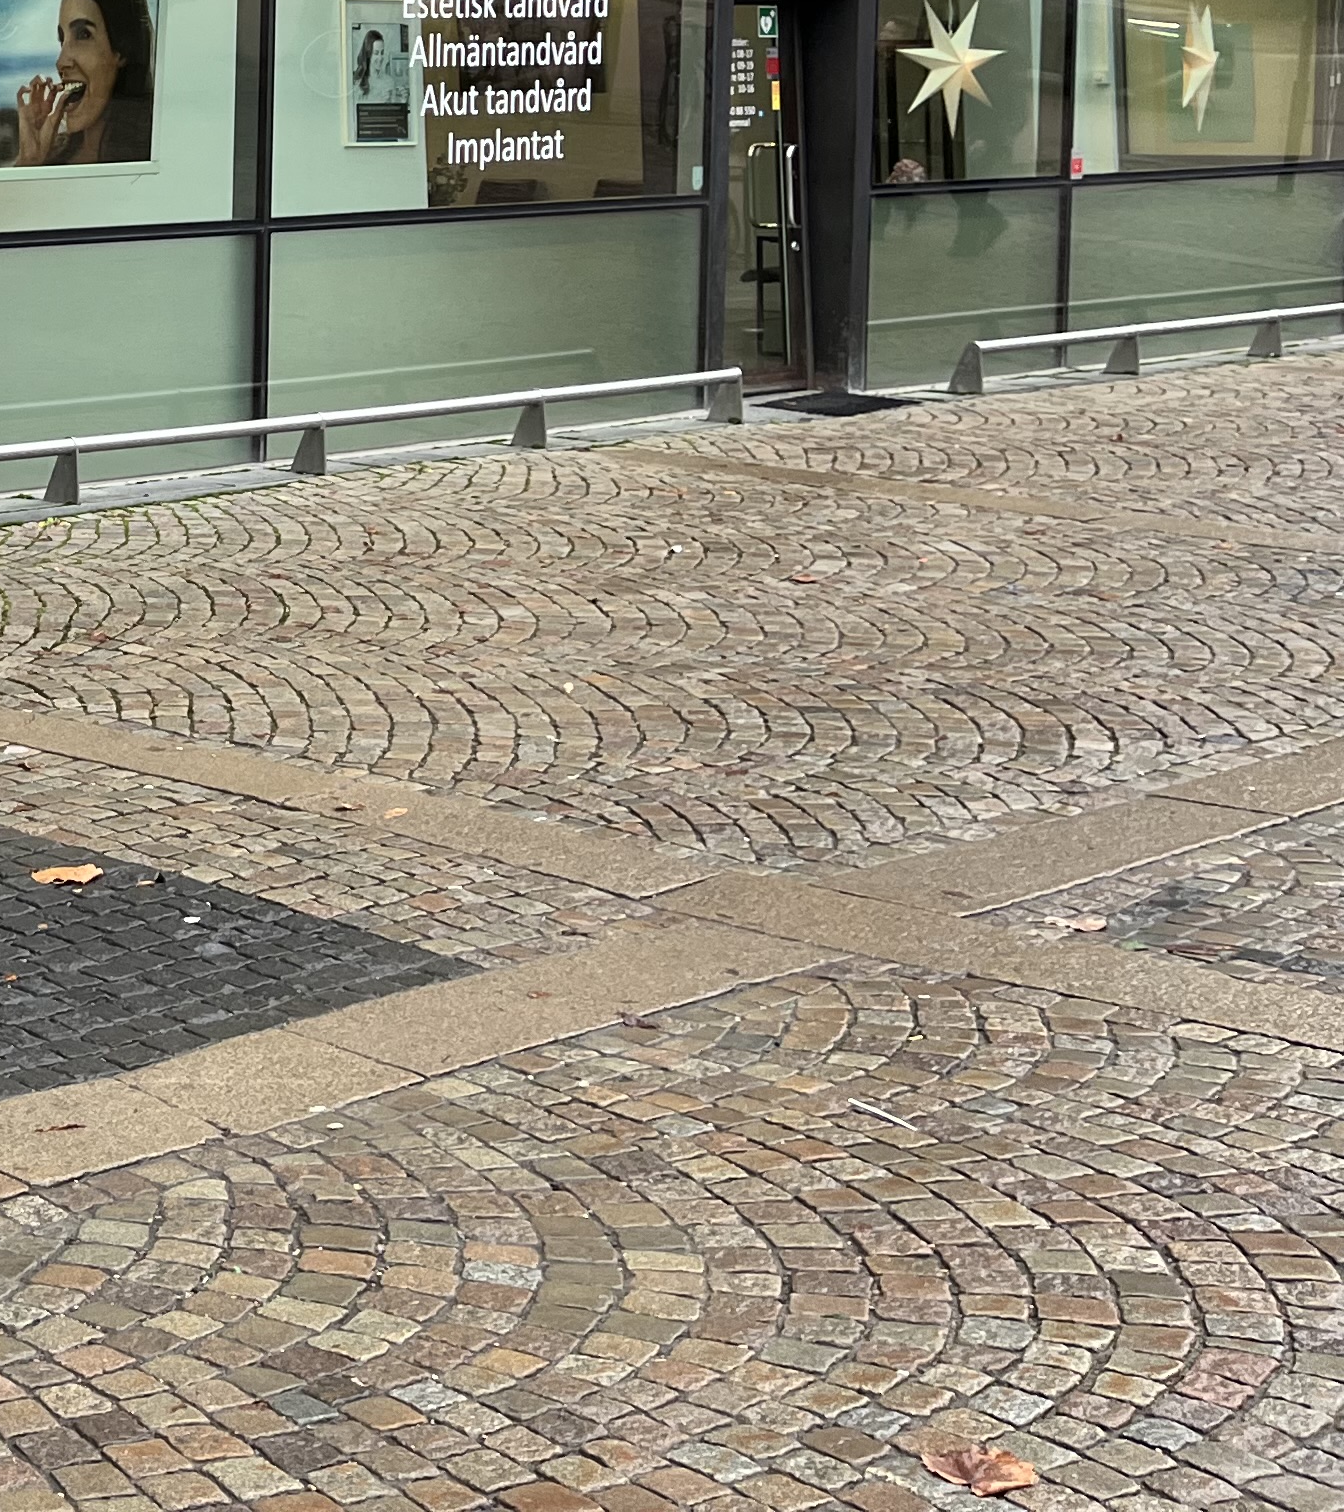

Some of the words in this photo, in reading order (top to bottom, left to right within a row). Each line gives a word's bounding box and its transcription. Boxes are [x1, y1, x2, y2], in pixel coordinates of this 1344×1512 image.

[409, 31, 603, 68] Allmäntandvård
[420, 81, 479, 117] Akut
[485, 77, 592, 115] tandvård
[448, 128, 565, 171] Implantat
